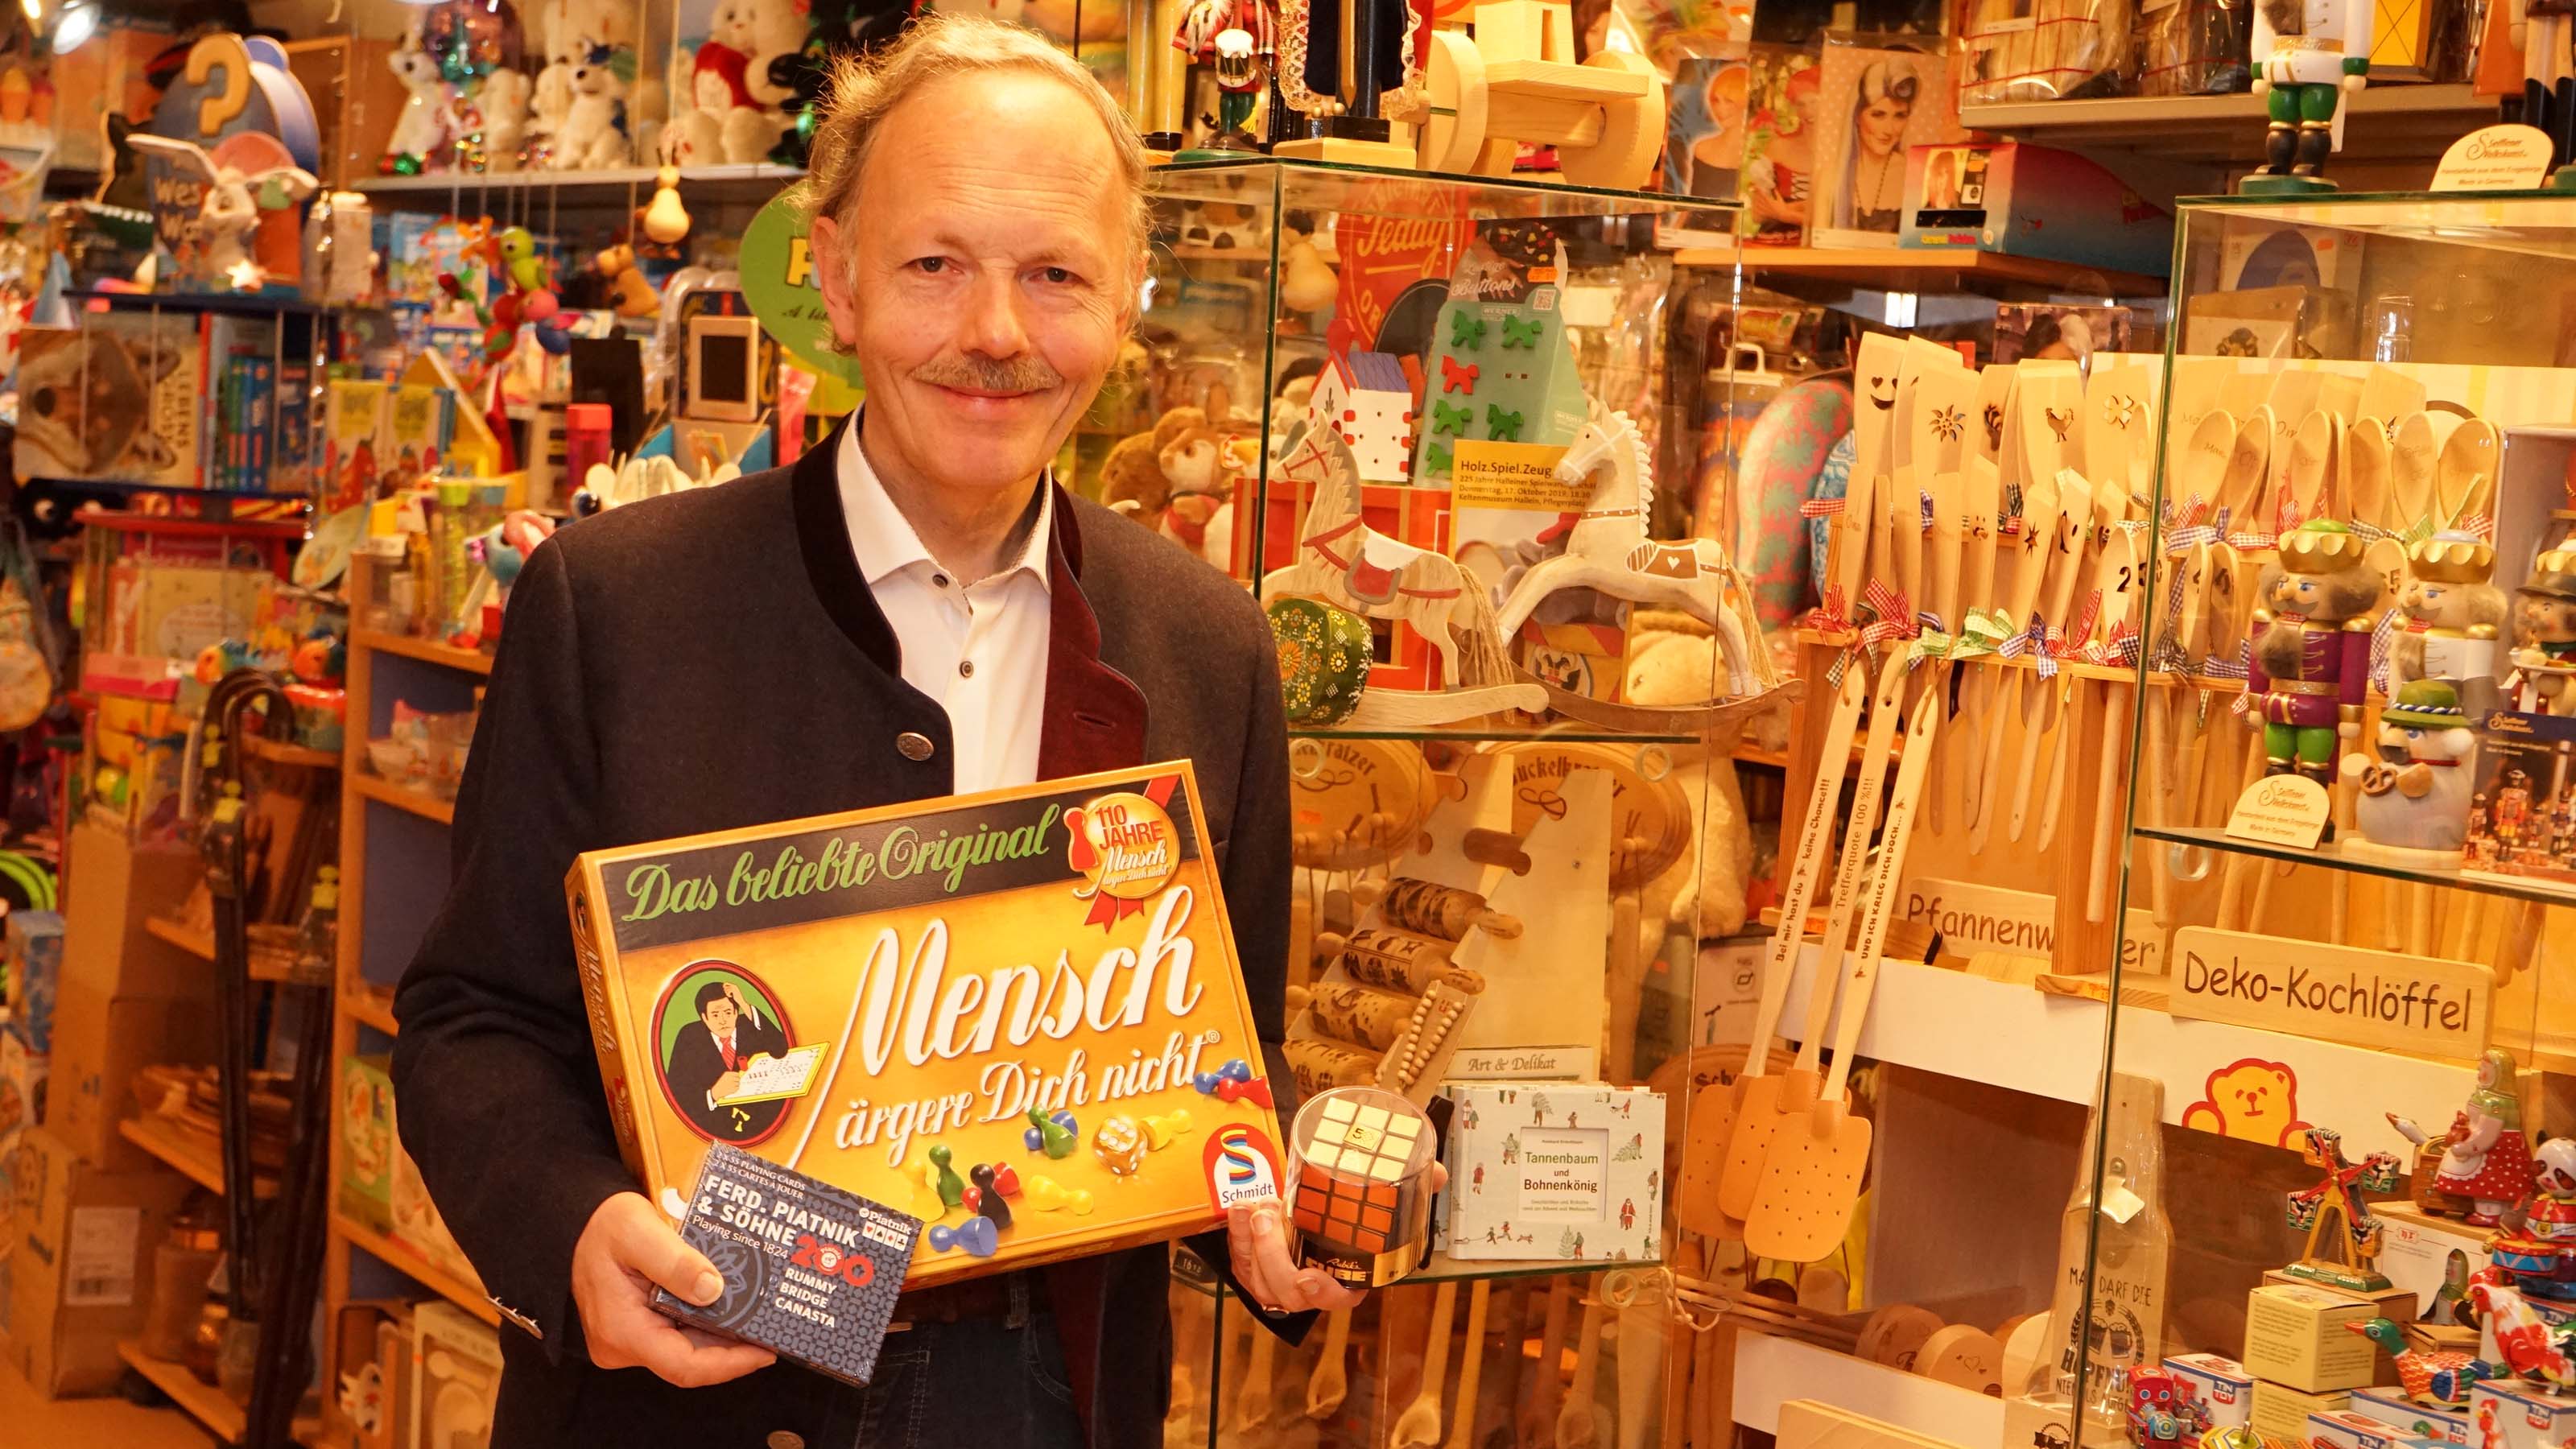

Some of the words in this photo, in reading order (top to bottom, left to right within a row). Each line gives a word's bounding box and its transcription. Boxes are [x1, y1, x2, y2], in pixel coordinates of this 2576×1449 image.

[1461, 460, 1552, 478] Holz.Spiel.Zeug
[1517, 487, 1546, 497] Oktober
[1096, 804, 1128, 828] 110
[1099, 819, 1164, 850] JAHRE
[1802, 833, 1817, 860] keine
[620, 863, 719, 922] Das
[726, 836, 876, 907] beliebte
[880, 803, 1060, 893] Original
[1092, 836, 1167, 883] Mensch
[1835, 830, 1862, 910] Trefferquote
[1855, 803, 1868, 826] 100
[1880, 856, 1893, 880] DICH
[1786, 898, 1799, 921] hast
[1872, 882, 1885, 915] KRIEG
[1783, 924, 1794, 942] mir
[1866, 918, 1877, 937] ICH
[1775, 943, 1787, 963] Bei
[1861, 939, 1872, 960] UND
[2184, 951, 2471, 1033] Deko-Kochlöffel
[805, 884, 1204, 1131] Mensch
[1468, 1058, 1492, 1072] Art
[1495, 1059, 1509, 1071] &
[1512, 1054, 1557, 1071] Delikat
[834, 1092, 974, 1168] ärgere
[979, 1049, 1090, 1123] Dich
[1525, 1151, 1599, 1164] Tannenbaum
[727, 1164, 737, 1174] 55
[738, 1168, 769, 1187] CARTES
[776, 1184, 805, 1200] JOUER
[730, 1155, 741, 1165] 55
[741, 1161, 777, 1180] PLAYING
[777, 1172, 806, 1191] CARDS
[1554, 1168, 1570, 1177] und
[1222, 1183, 1274, 1203] Schmidt
[1524, 1179, 1598, 1194] Bohnenkönig
[697, 1195, 713, 1216] &
[720, 1204, 797, 1247] SÖHNE
[704, 1174, 767, 1214] FERD.
[773, 1200, 859, 1248] PIATNIK
[869, 1210, 912, 1235] Piatnik
[692, 1214, 731, 1240] Playing
[732, 1230, 761, 1250] since
[762, 1242, 789, 1261] 1824
[785, 1267, 837, 1294] RUMMY
[2099, 1276, 2128, 1300] DARF
[2133, 1285, 2152, 1307] DIE
[780, 1282, 829, 1309] BRIDGE
[775, 1297, 836, 1328] CANASTA
